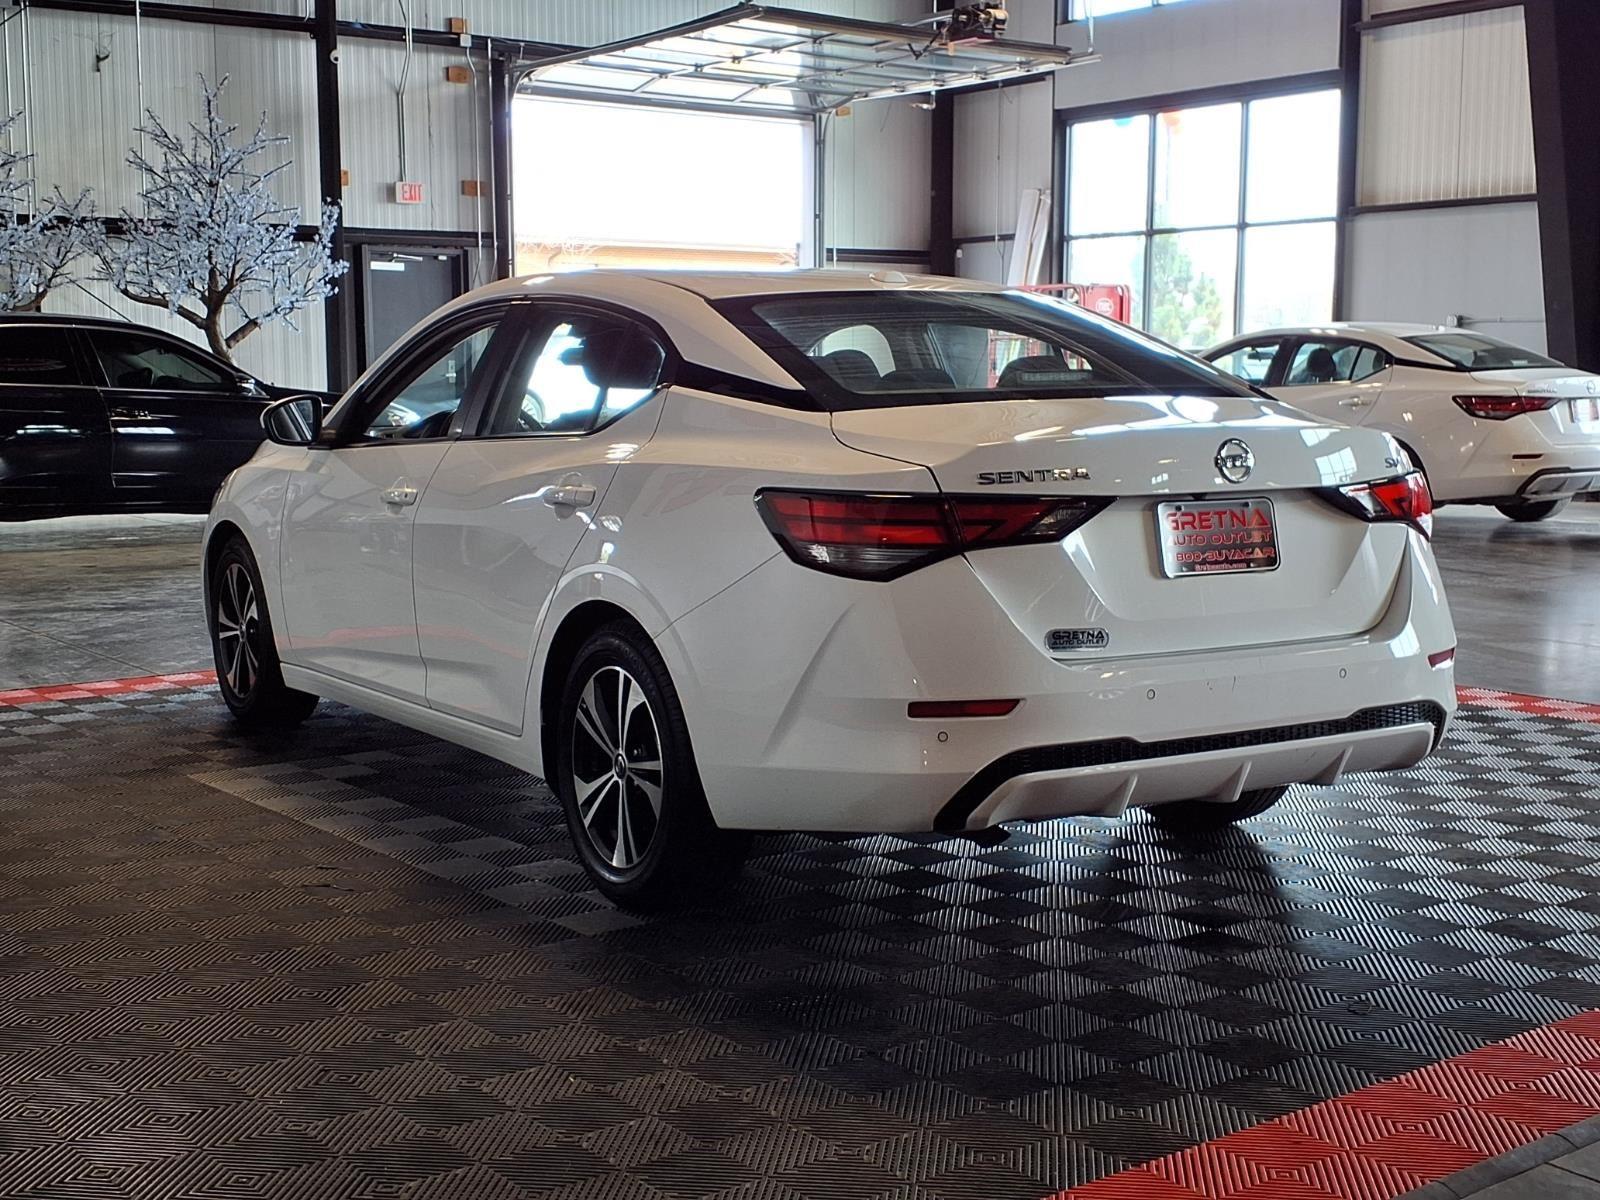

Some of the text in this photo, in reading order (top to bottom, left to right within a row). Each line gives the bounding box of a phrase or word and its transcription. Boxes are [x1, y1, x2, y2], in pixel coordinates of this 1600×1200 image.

[401, 183, 422, 201] EXIT
[977, 468, 1091, 486] SENTRA
[1166, 508, 1270, 531] GRETNA
[1211, 530, 1273, 545] OUTLET
[1051, 630, 1105, 640] GRETNA
